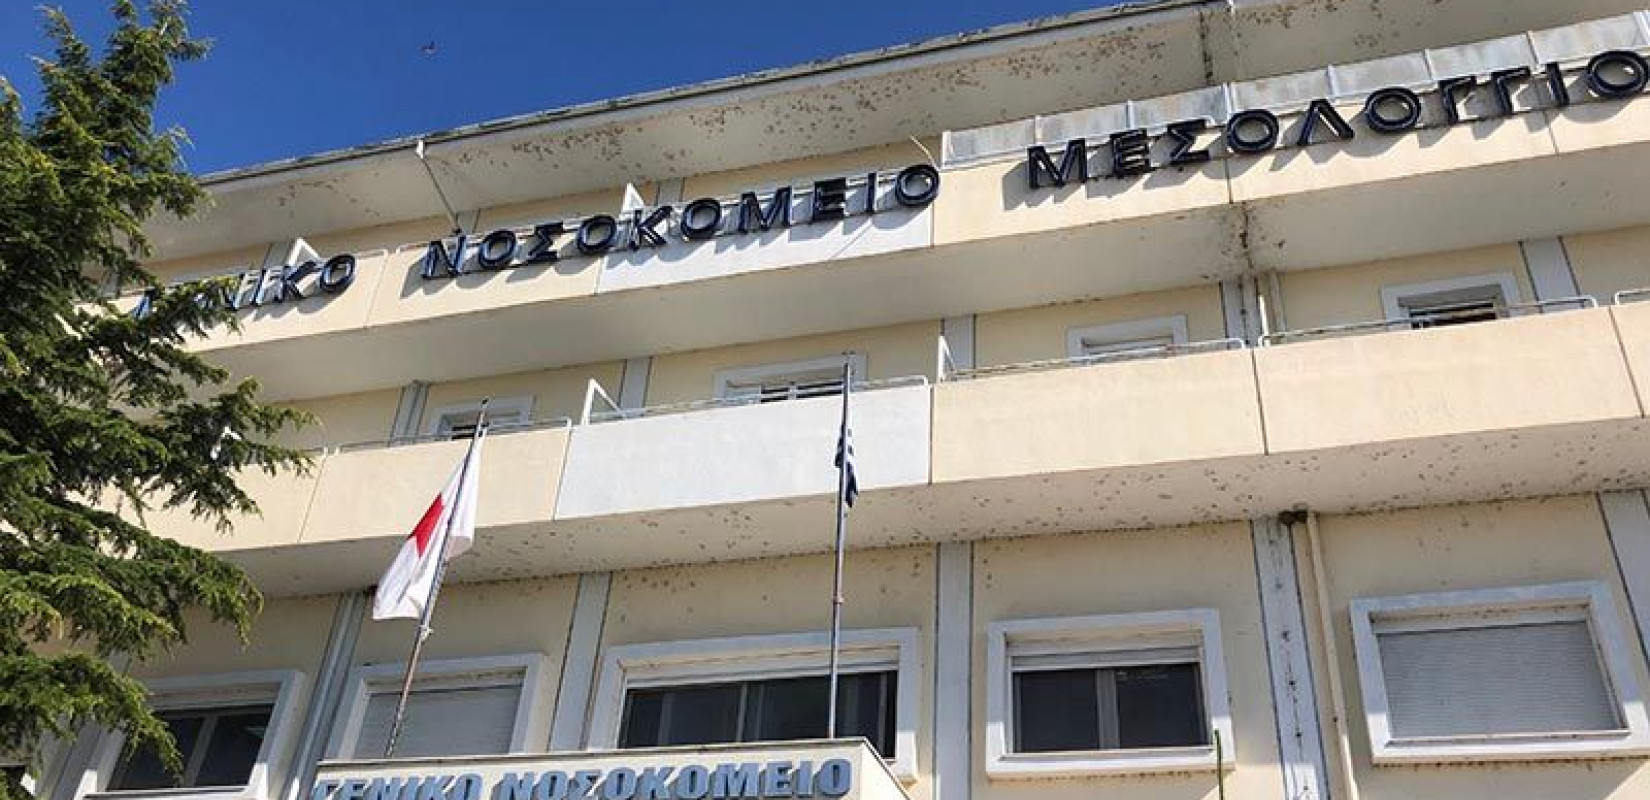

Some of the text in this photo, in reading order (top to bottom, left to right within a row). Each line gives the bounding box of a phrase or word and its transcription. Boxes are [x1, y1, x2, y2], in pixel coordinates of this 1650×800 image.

[420, 163, 941, 281] ΝΟΣΟΚΟΜΕΙΟ
[1027, 50, 1649, 189] ΜΕΣΟΛΟΓΓΙΟ
[493, 758, 852, 800] ΝΟΣΟΚΟΜΕΙΟ
